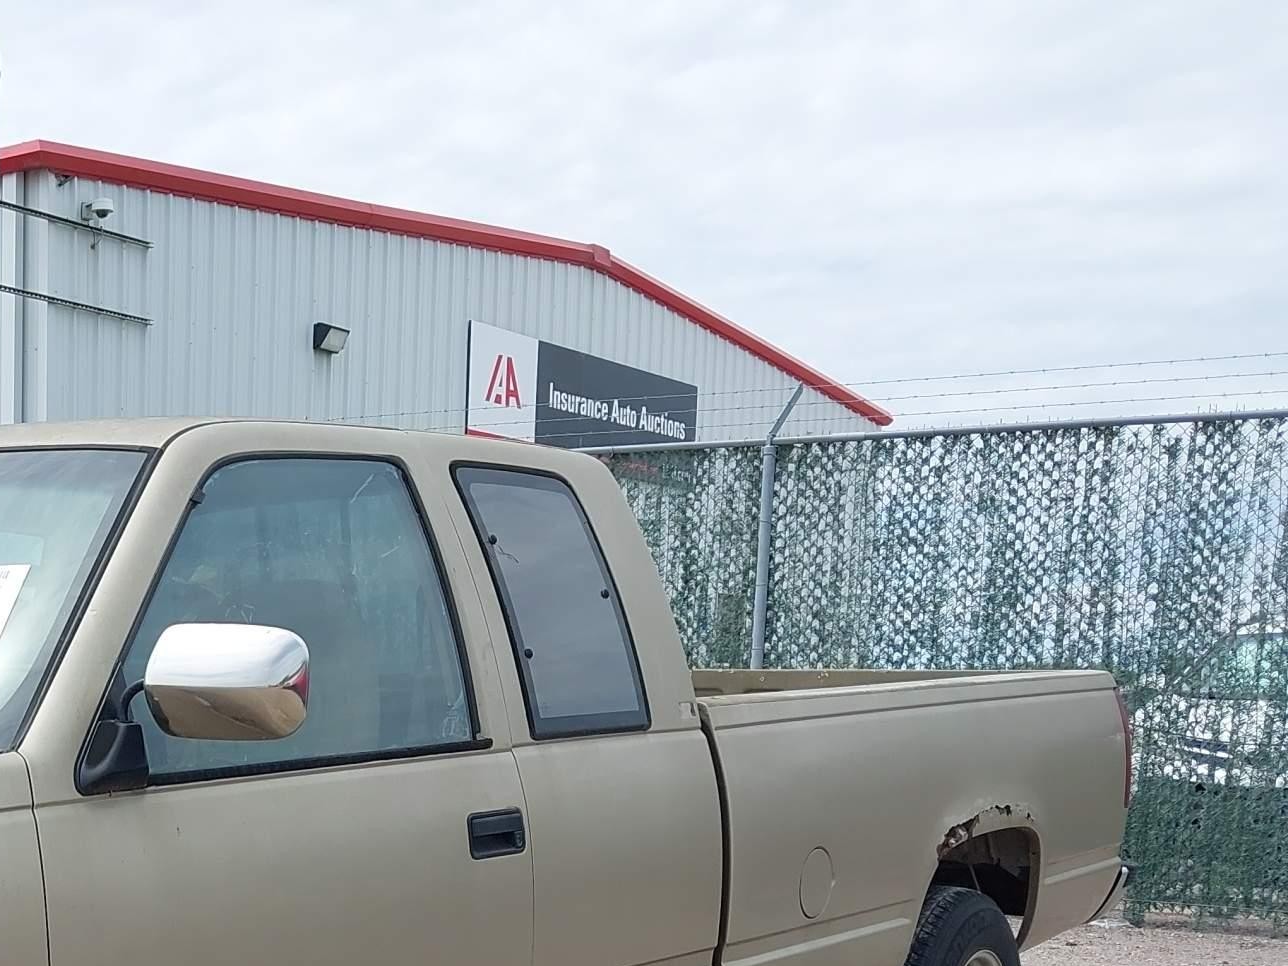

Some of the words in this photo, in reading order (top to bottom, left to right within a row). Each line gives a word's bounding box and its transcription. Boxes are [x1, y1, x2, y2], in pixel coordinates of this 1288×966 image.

[548, 382, 609, 421] Insurance
[610, 399, 637, 428] Auto
[638, 406, 686, 440] Auctions
